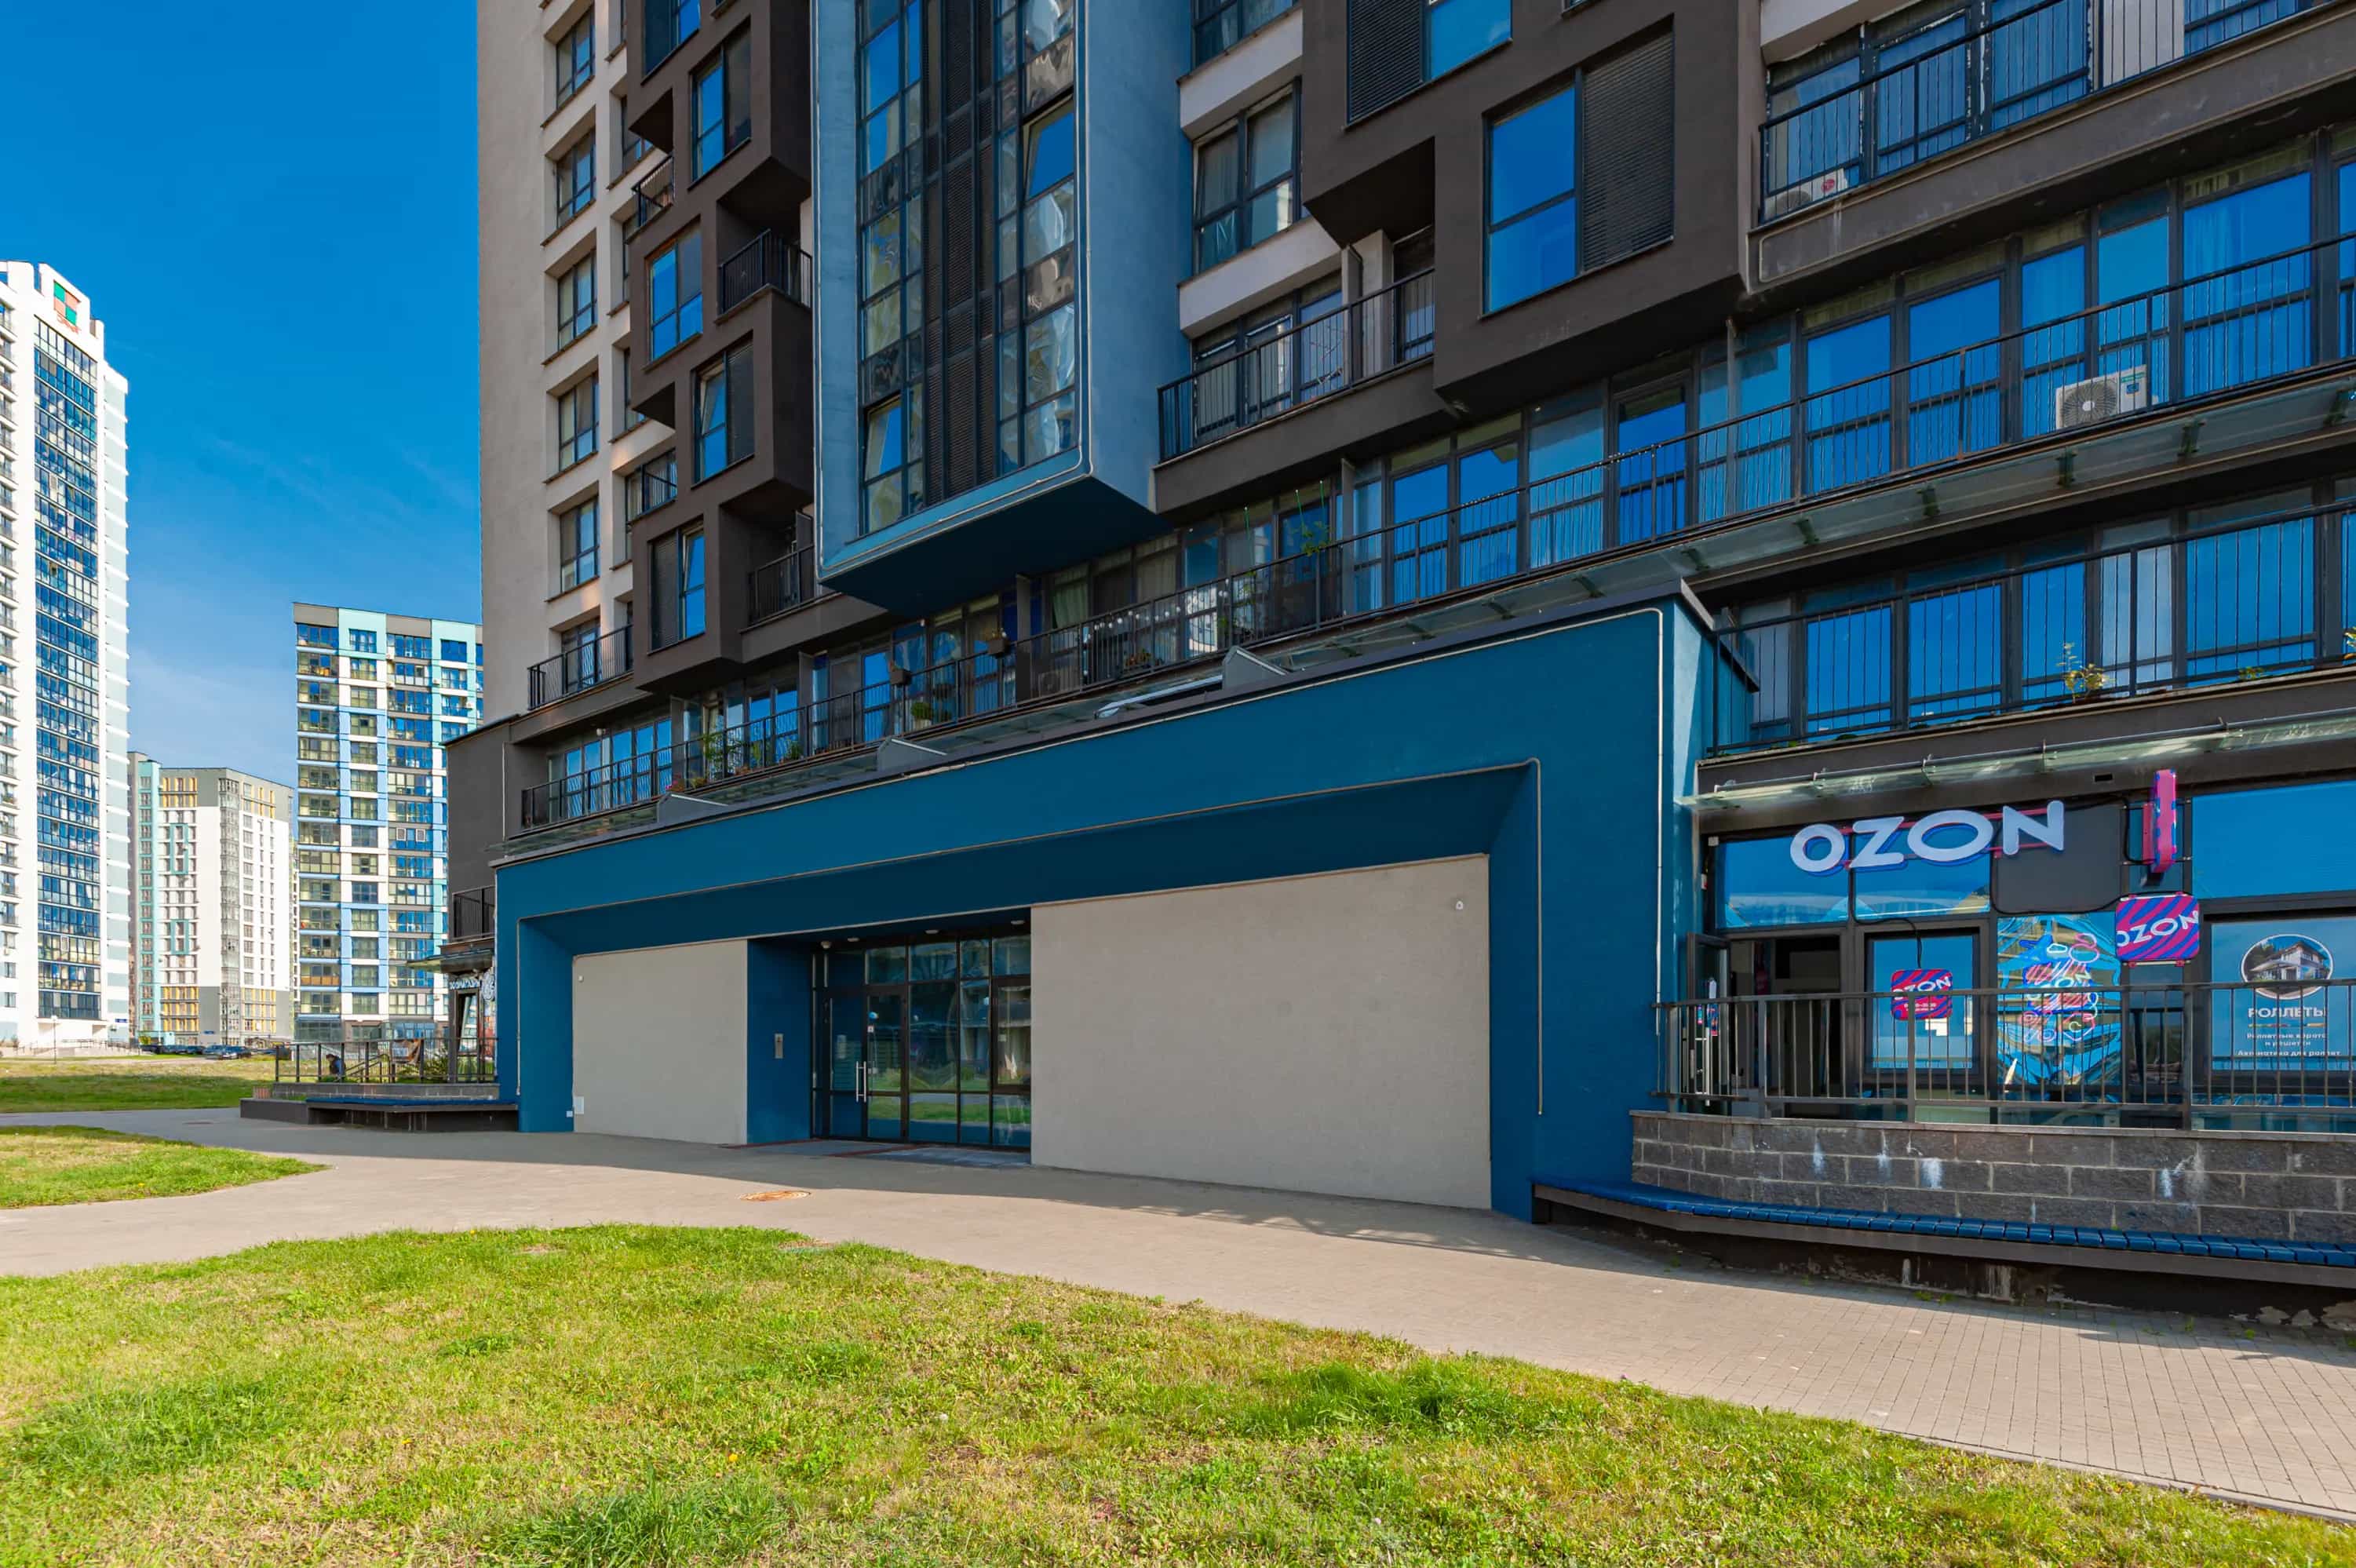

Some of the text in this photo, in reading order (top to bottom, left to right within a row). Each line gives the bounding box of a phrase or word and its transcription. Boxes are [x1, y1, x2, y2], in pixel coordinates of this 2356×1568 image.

[1790, 800, 2065, 873] OZON
[2117, 910, 2199, 947] OZON
[2247, 1006, 2327, 1019] РОЛЛЕТЫ
